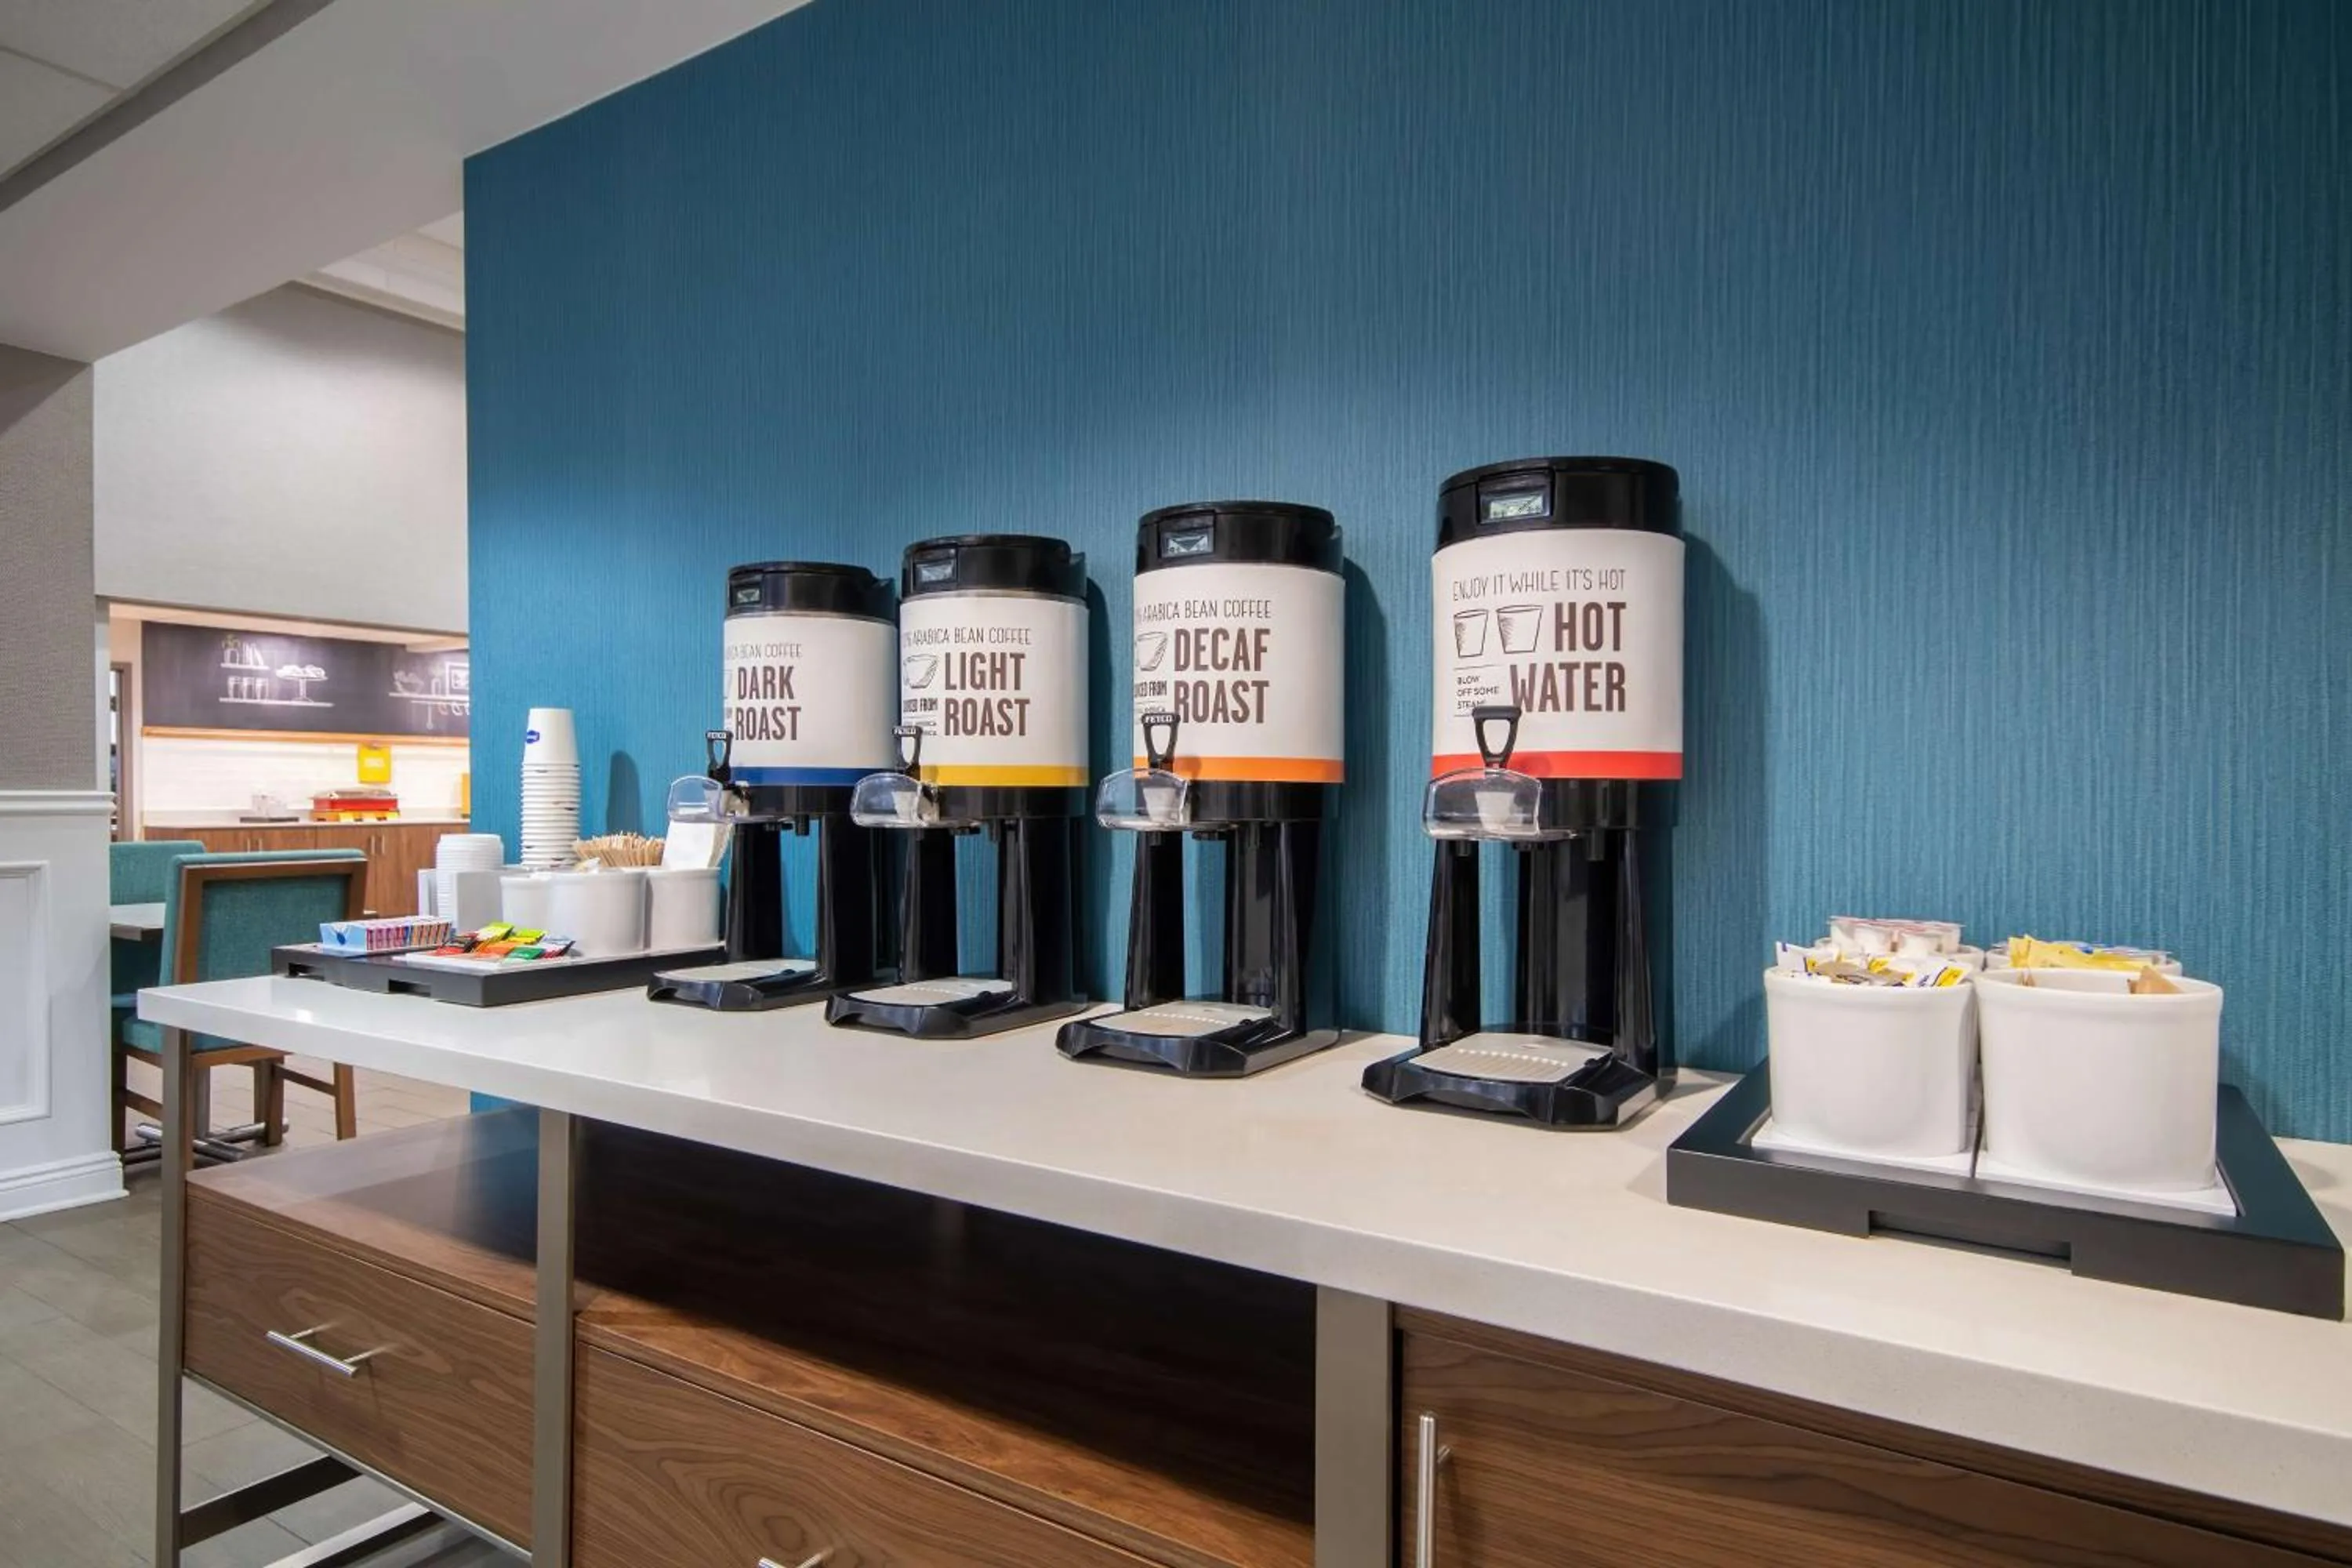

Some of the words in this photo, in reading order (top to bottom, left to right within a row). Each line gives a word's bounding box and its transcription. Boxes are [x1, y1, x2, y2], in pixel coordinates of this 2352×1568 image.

[1453, 575, 1488, 601] ENJOY
[1493, 574, 1505, 595] IT
[1509, 570, 1559, 593] WHILE
[1566, 568, 1592, 591] IT'S
[1599, 569, 1626, 591] HOT
[1185, 600, 1218, 619] BEAN
[1224, 600, 1272, 619] COFFEE
[1555, 601, 1627, 652] HOT
[765, 642, 803, 659] COFFEE
[954, 626, 984, 644] BEAN
[989, 627, 1032, 645] COFFEE
[1174, 627, 1271, 672] DECAF
[738, 665, 794, 700] DARK
[945, 652, 1026, 691] LIGHT
[1510, 662, 1626, 713] WATER
[944, 697, 1030, 736] ROAST
[1174, 680, 1270, 724] ROAST
[735, 706, 802, 741] ROAST
